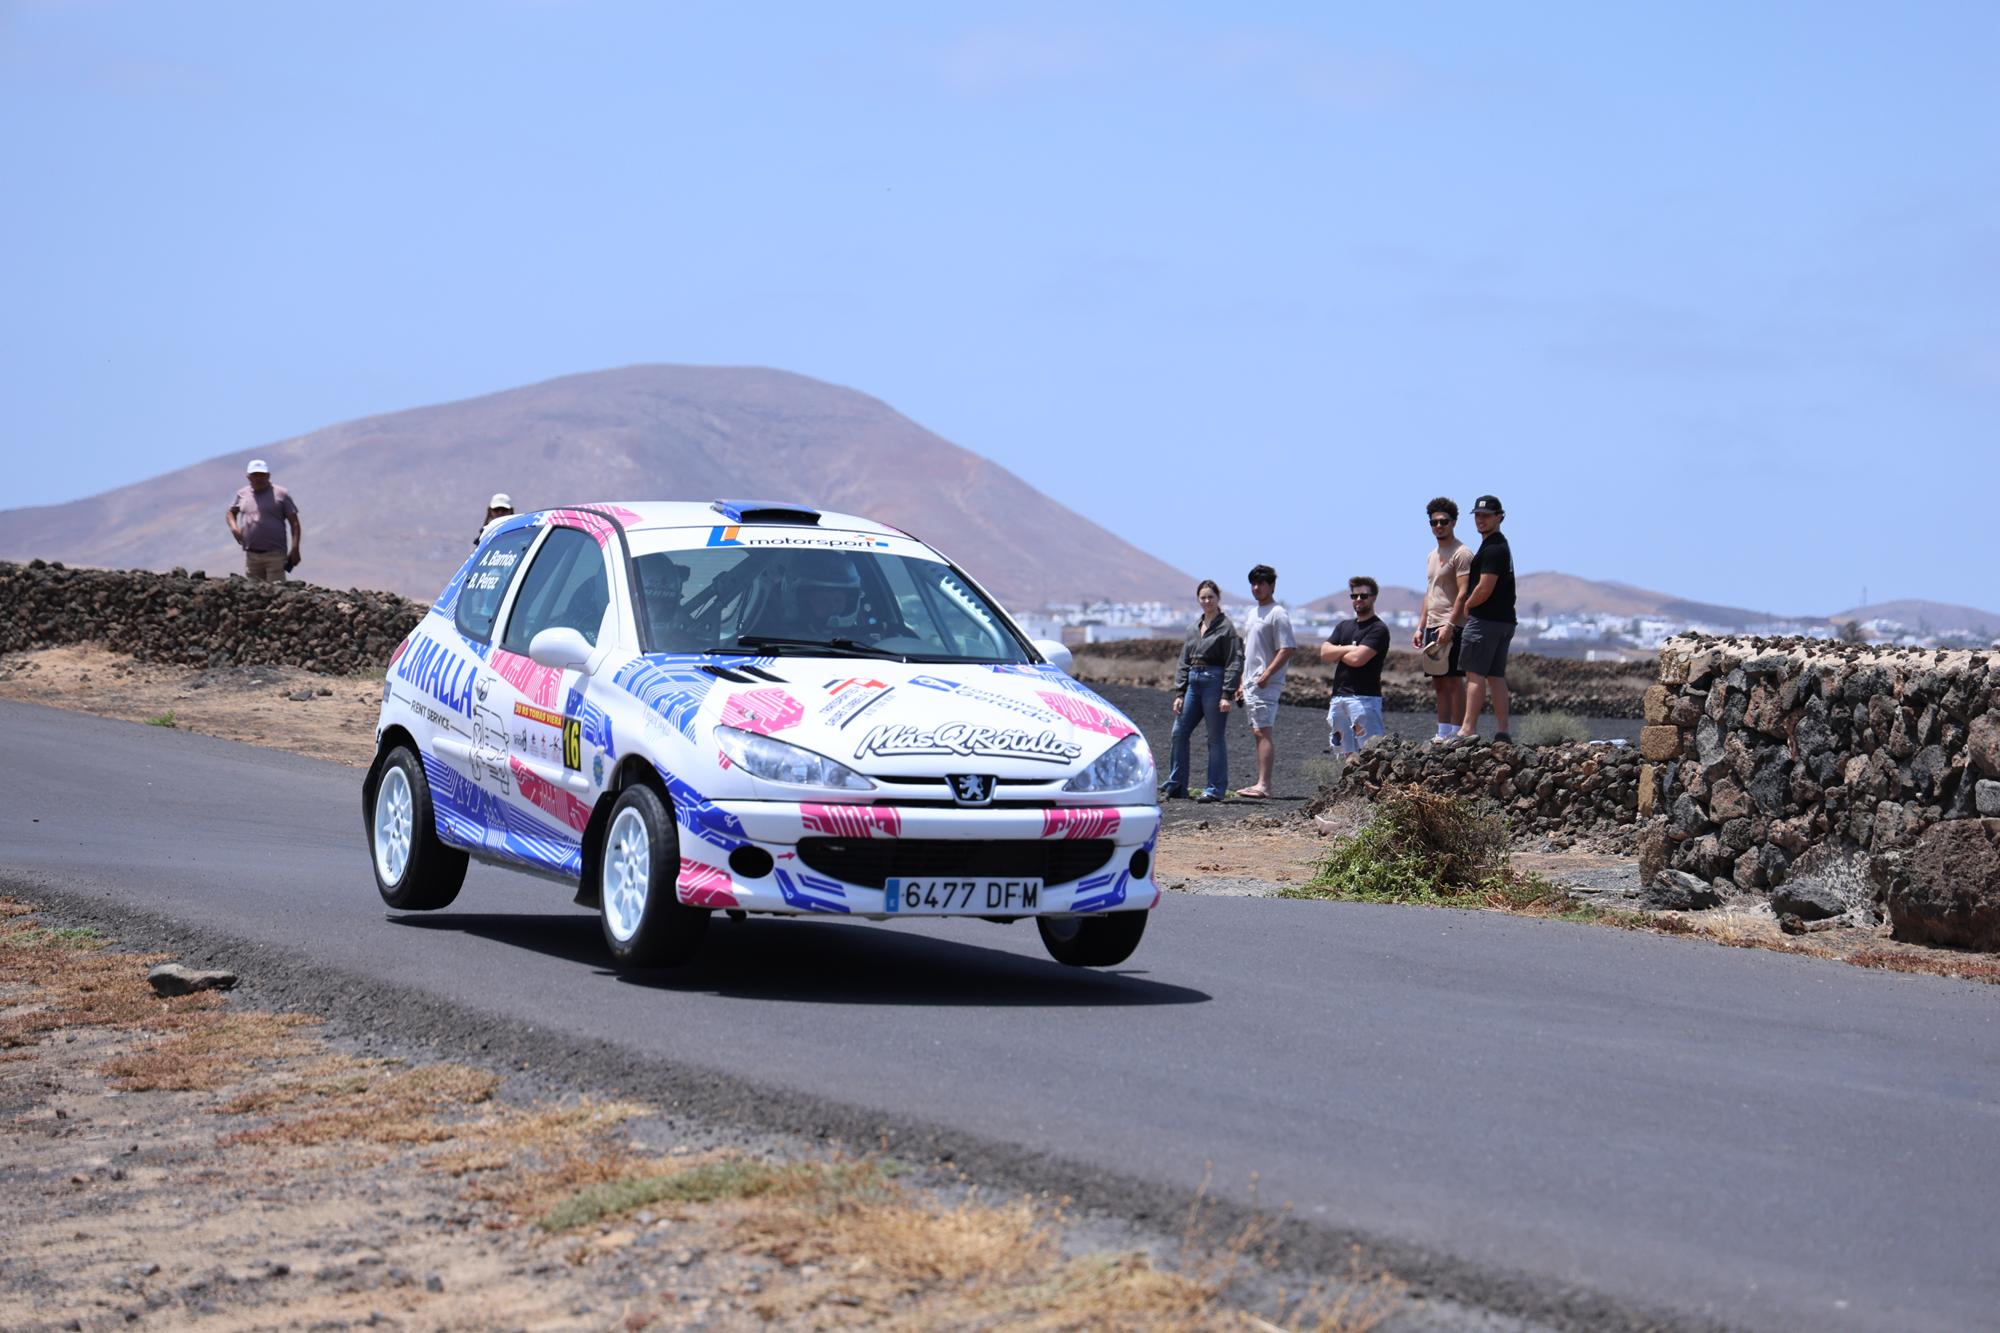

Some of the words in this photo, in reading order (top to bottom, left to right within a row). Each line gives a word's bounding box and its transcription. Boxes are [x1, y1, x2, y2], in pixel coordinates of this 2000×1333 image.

[749, 537, 873, 547] motorsport
[479, 550, 491, 567] A.
[488, 550, 518, 567] Barrios
[467, 572, 479, 589] B.
[475, 572, 499, 589] Pérez
[397, 632, 478, 719] LIMALLA
[410, 700, 427, 718] RENT
[427, 708, 450, 731] SERVICE
[955, 690, 1052, 723] Gerardo
[563, 720, 580, 769] 16
[905, 882, 976, 908] 6477
[987, 882, 1037, 908] DFM
